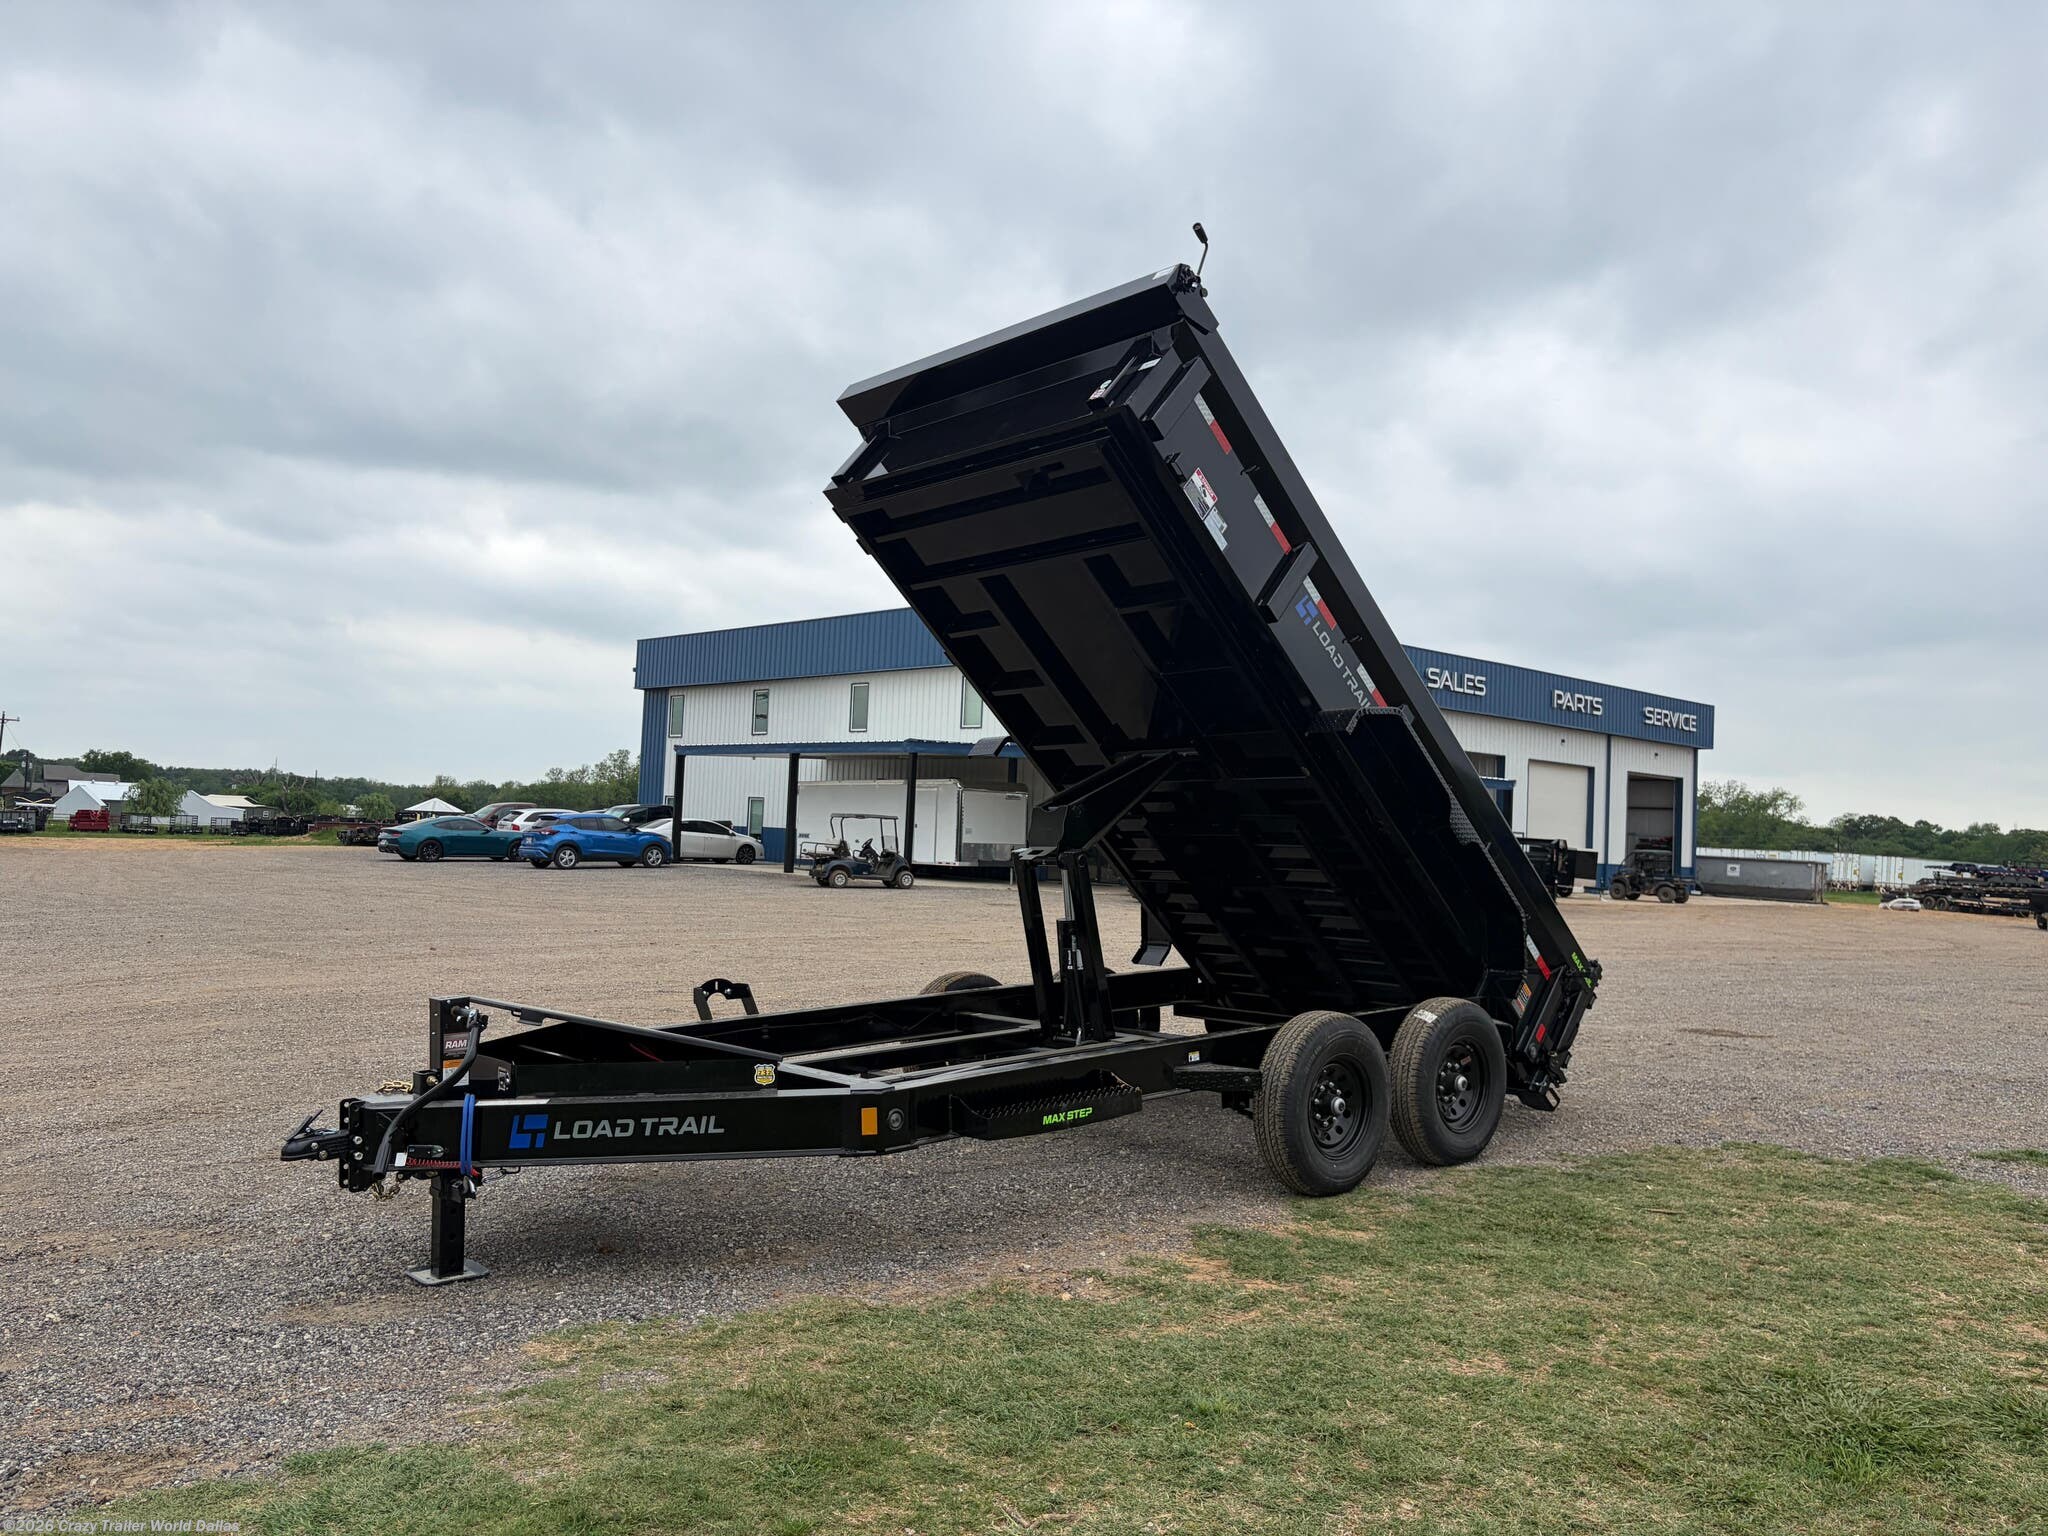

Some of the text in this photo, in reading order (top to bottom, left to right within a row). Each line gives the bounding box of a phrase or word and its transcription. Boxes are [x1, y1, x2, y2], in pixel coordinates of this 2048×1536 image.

[1312, 621, 1344, 669] LOAD
[1426, 667, 1487, 696] SALES
[1553, 690, 1603, 716] PARTS
[1644, 706, 1697, 732] SERVICE
[445, 1039, 468, 1049] RAM
[553, 1115, 725, 1140] LOAD TRAIL
[1043, 1107, 1093, 1125] MAX STEP
